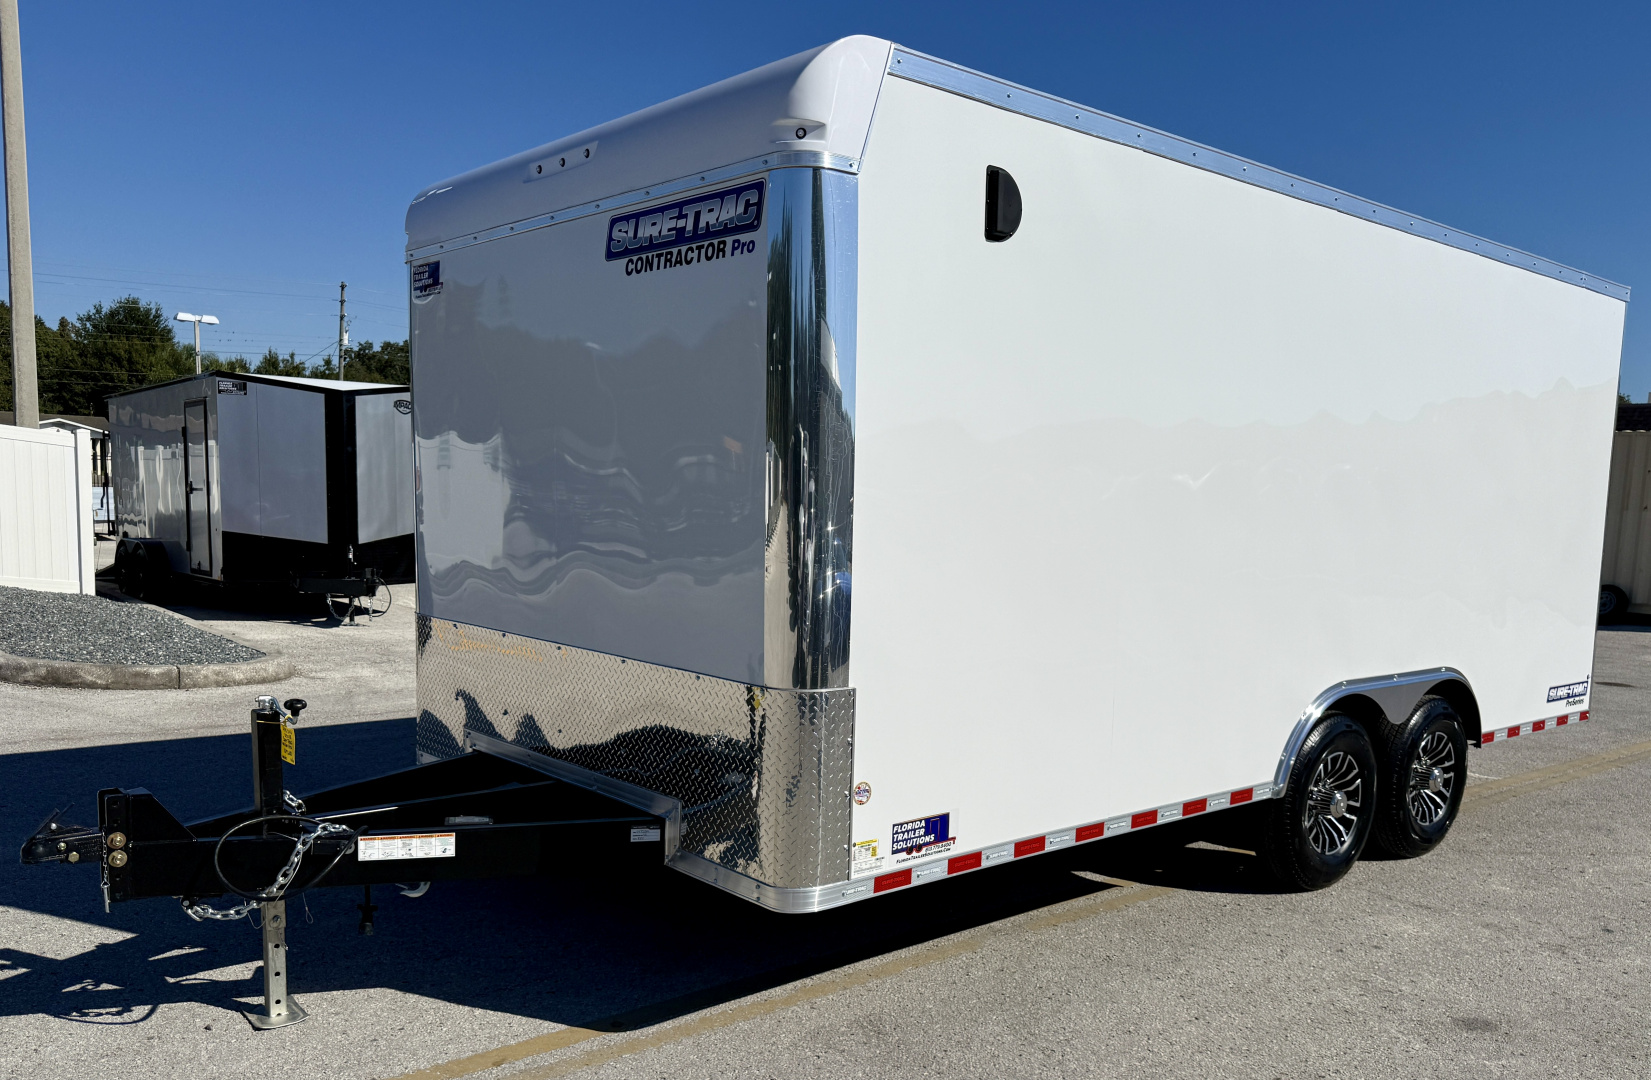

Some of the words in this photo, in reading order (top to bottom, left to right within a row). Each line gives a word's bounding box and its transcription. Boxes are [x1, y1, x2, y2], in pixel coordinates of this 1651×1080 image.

[611, 189, 759, 252] SURE-TRAC
[625, 240, 727, 277] CONTRACTOR
[731, 238, 756, 257] Pro
[1548, 682, 1588, 701] SURE-TRAC
[893, 819, 926, 834] FLORIDA
[893, 828, 926, 842] TRAILER
[892, 834, 935, 851] SOLUTIONS
